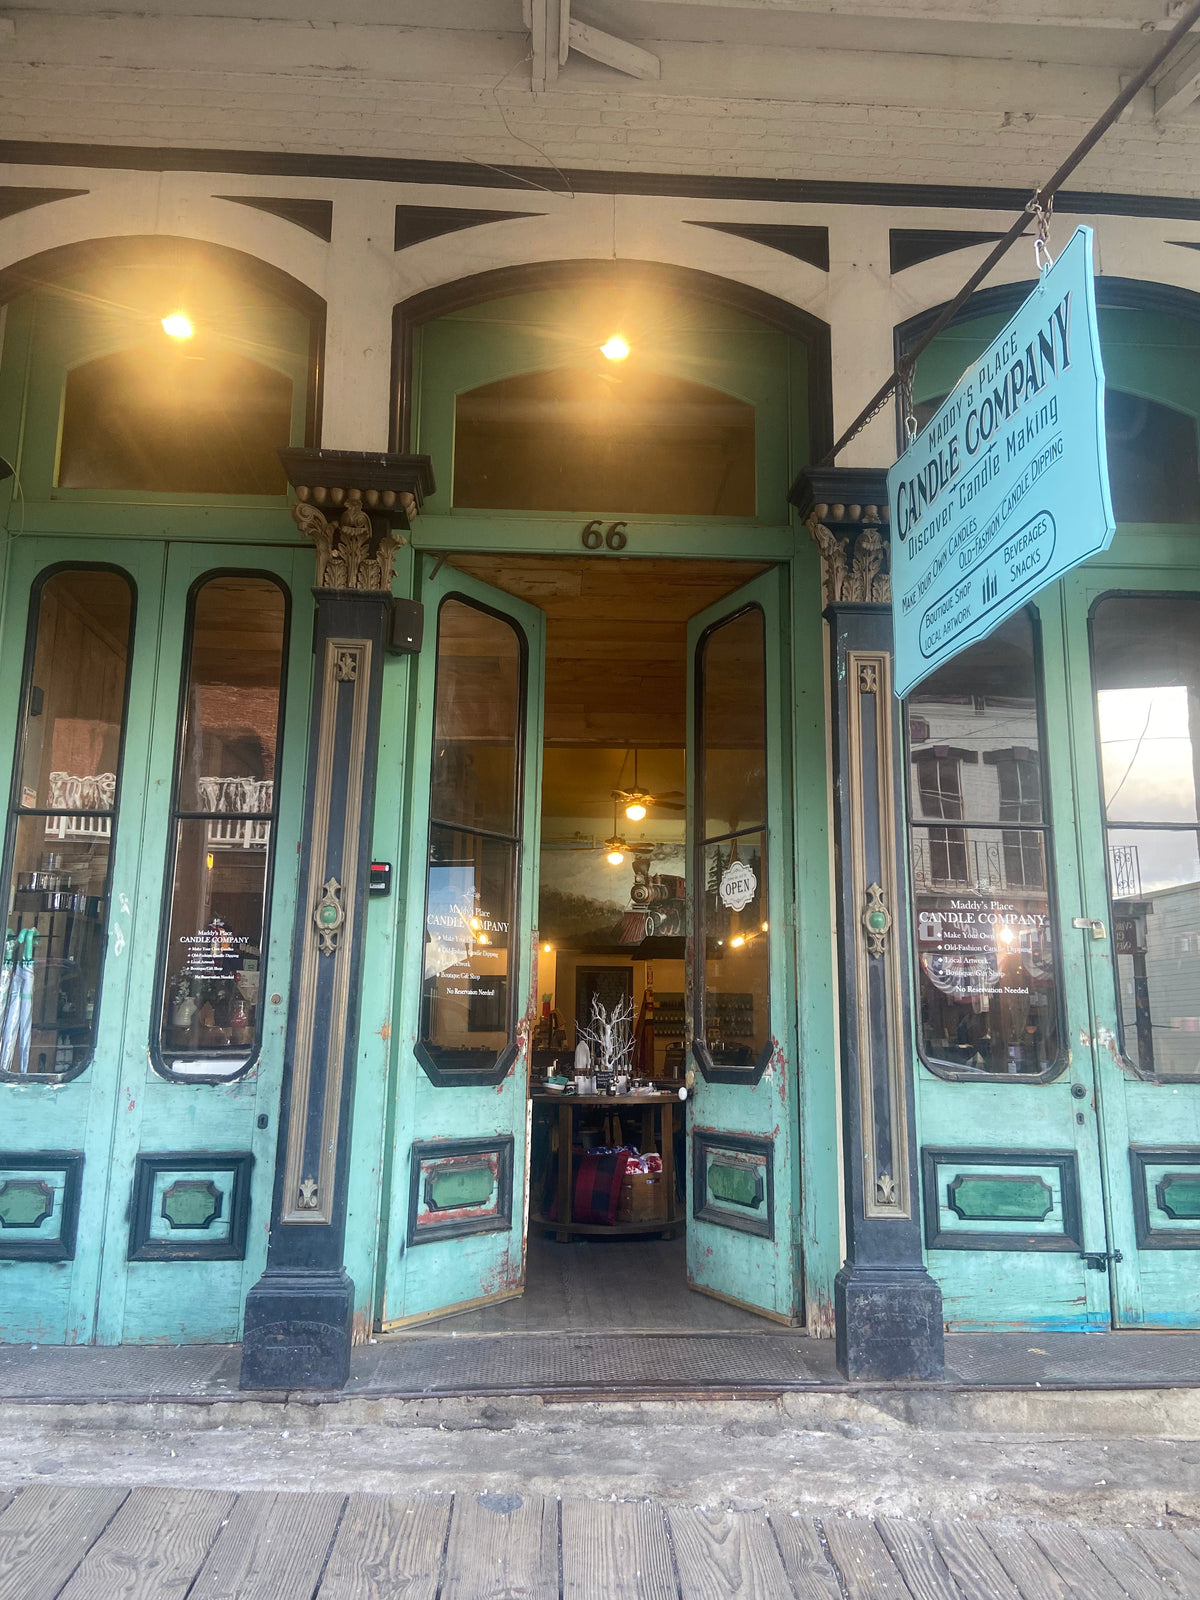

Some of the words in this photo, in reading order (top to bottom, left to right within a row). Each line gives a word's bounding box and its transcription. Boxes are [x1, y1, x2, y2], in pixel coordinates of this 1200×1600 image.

[928, 384, 974, 453] MADDY'S
[979, 331, 1017, 393] PLACE
[897, 434, 961, 543] CANDLE
[965, 291, 1073, 456] COMPANY
[908, 501, 954, 561] Discover
[960, 451, 1000, 509] Candle
[1006, 395, 1058, 462] Making
[582, 520, 627, 550] 66
[725, 878, 750, 896] OPEN
[449, 903, 474, 917] Mdy's
[475, 908, 490, 917] Place
[951, 900, 988, 911] Maddy's
[990, 901, 1014, 910] Place
[427, 914, 465, 928] CANDLE
[919, 912, 975, 924] CANDLE
[978, 913, 1046, 926] COMPANY
[967, 986, 1003, 994] Reservation
